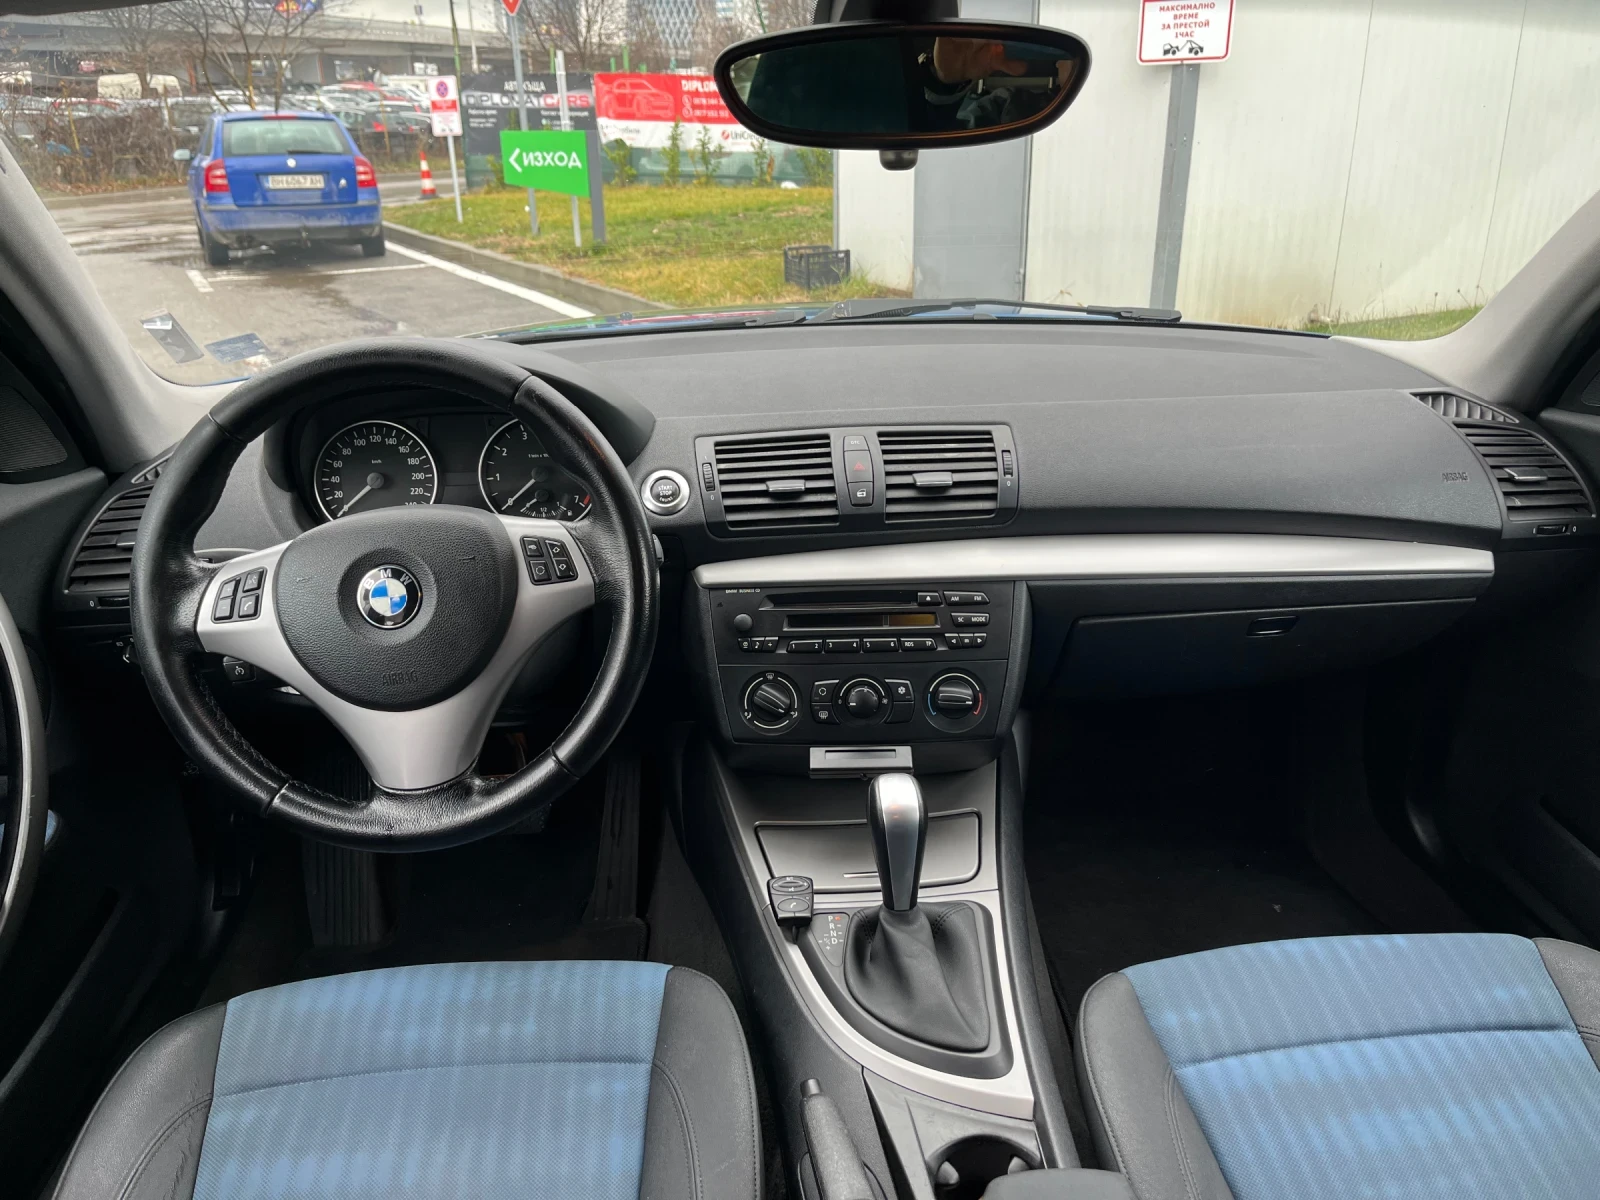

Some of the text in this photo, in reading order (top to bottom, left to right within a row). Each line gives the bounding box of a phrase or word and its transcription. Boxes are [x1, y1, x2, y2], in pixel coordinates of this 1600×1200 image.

[1159, 2, 1216, 12] МАКСИМАЛНО
[1173, 12, 1199, 20] ВРЕМЕ
[1173, 19, 1210, 30] ПРЕСТОЙ
[504, 81, 546, 92] АВТКЪЩА
[522, 151, 582, 169] ИЗХОД
[522, 432, 528, 440] 3
[502, 448, 508, 456] 2
[495, 473, 500, 481] 1
[574, 495, 579, 503] 7
[363, 568, 412, 590] BMW
